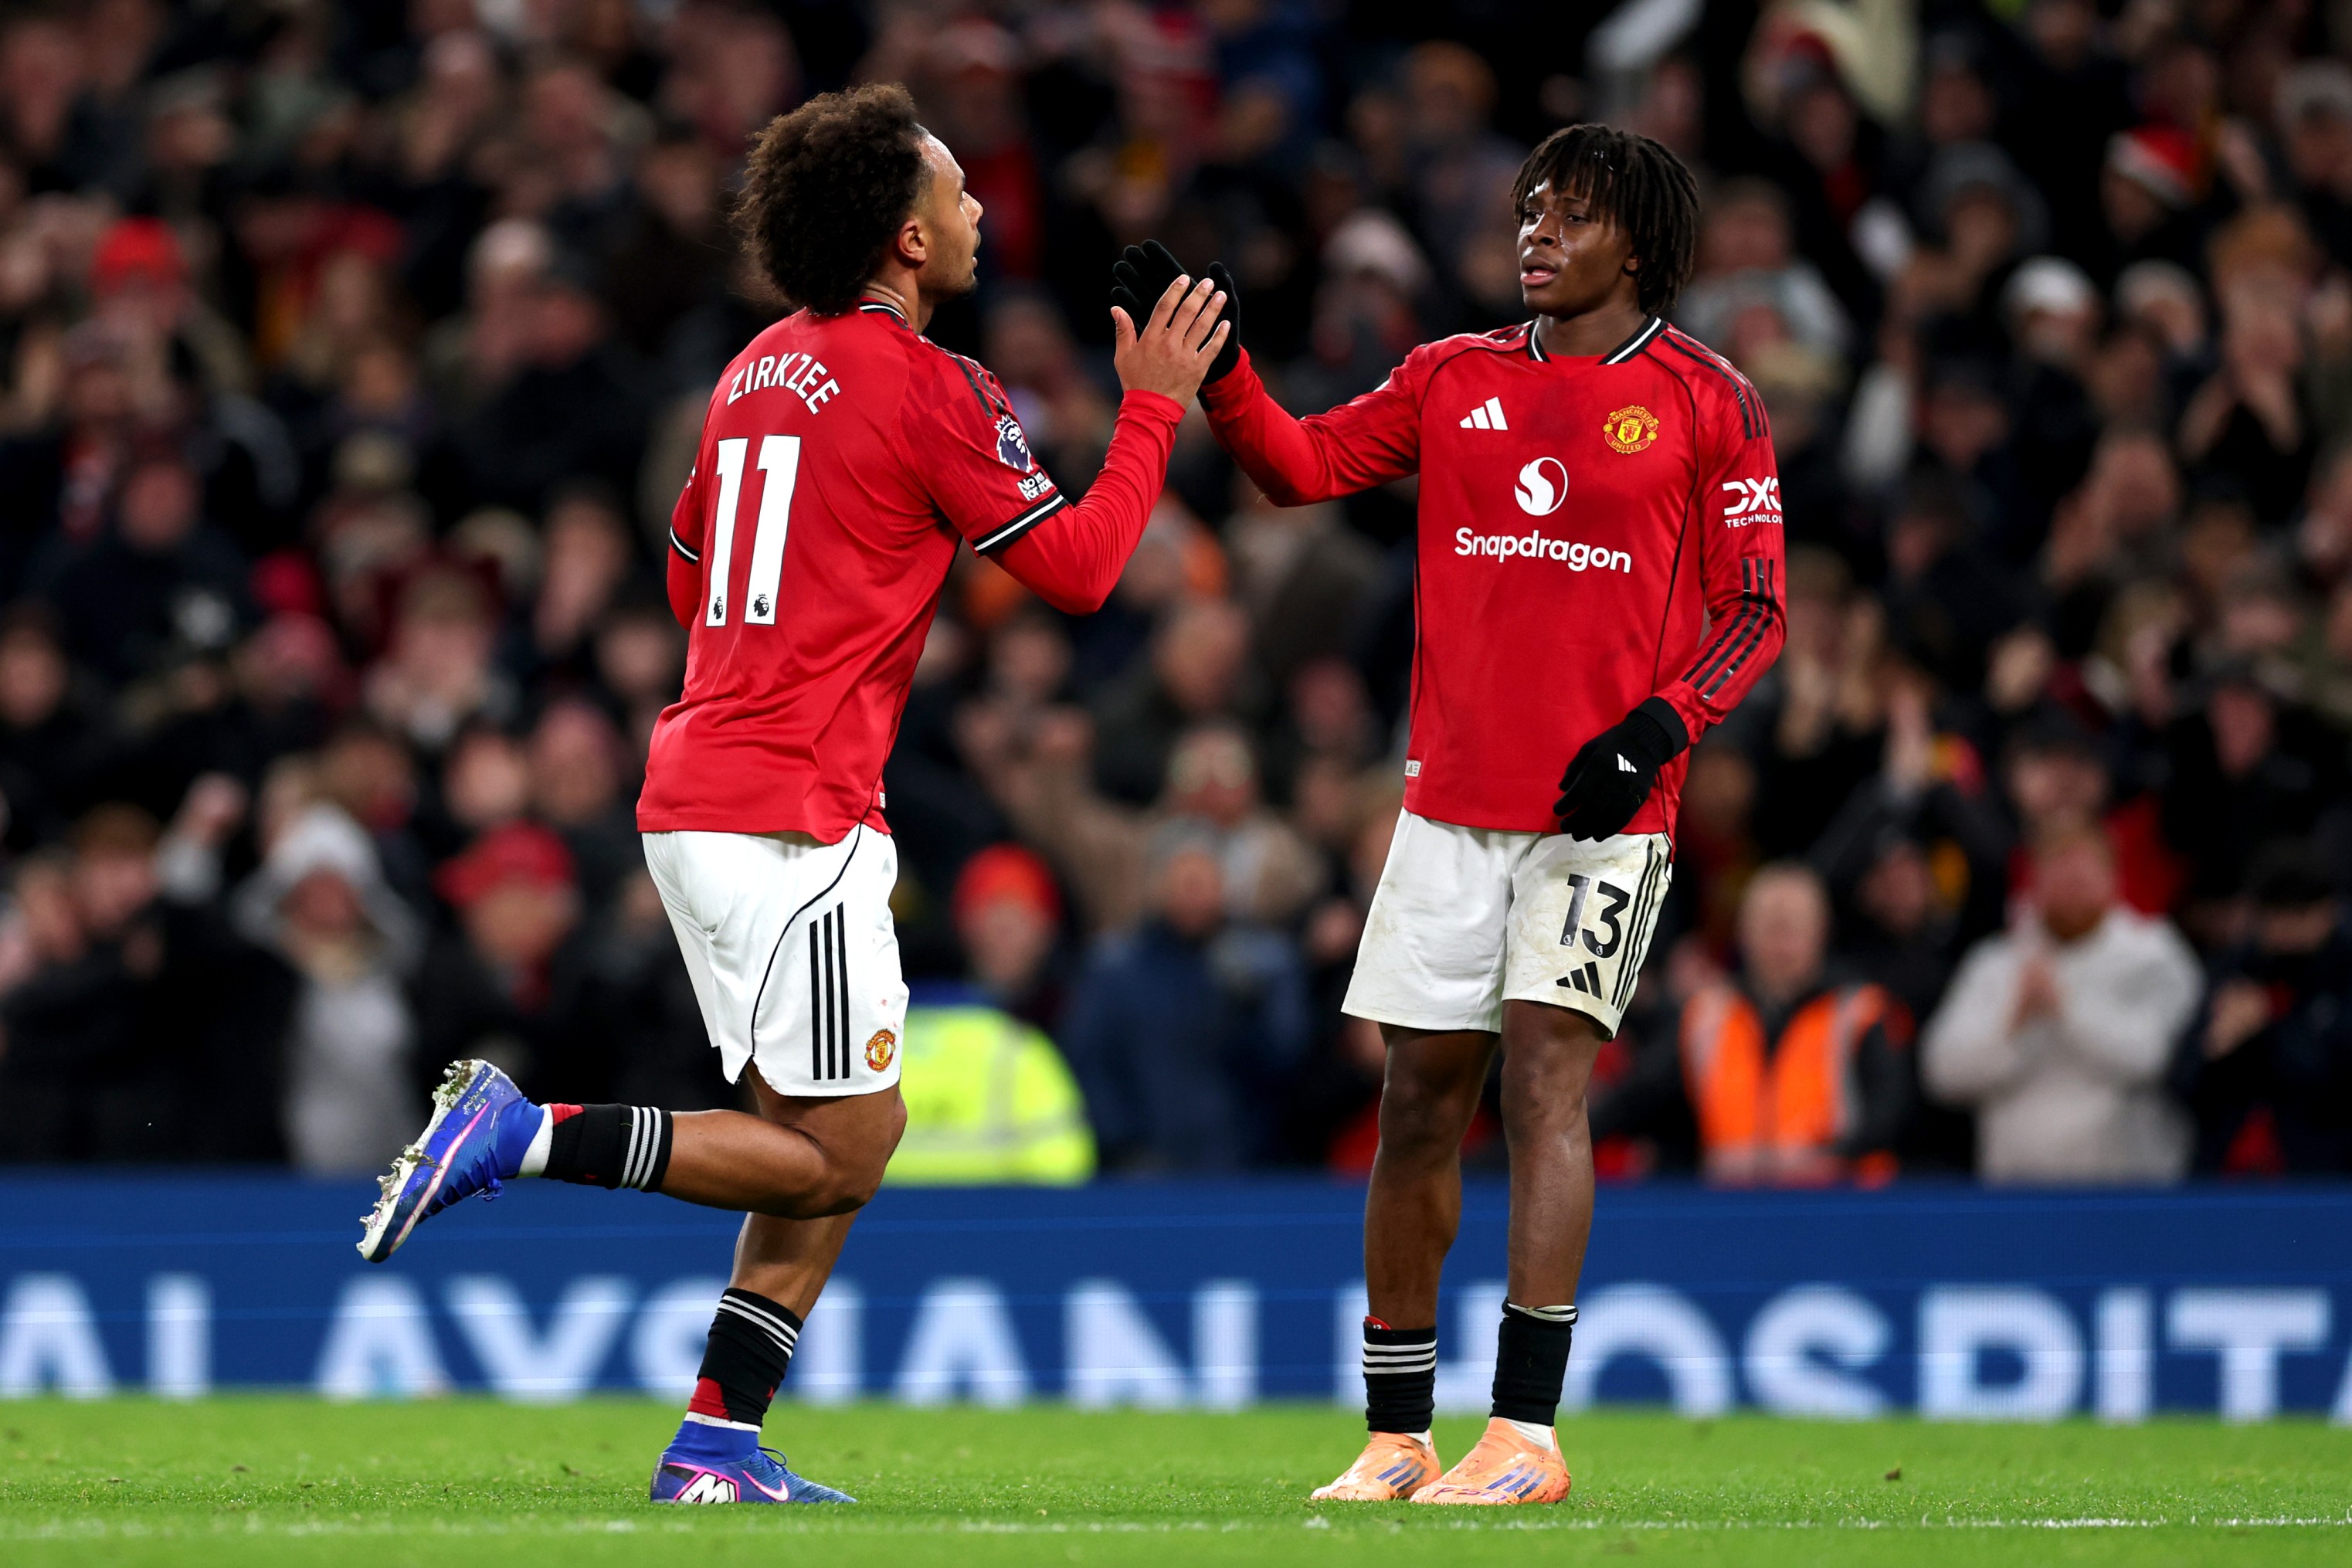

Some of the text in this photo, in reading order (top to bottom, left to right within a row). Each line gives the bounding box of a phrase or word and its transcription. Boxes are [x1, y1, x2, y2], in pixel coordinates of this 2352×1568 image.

[727, 352, 840, 415] ZIRKZEE
[1610, 440, 1641, 450] UNITED
[1611, 409, 1655, 429] MANCHESTER
[706, 434, 802, 626] 11
[1454, 527, 1632, 574] Snapdragon
[1560, 873, 1631, 959] 13
[1332, 1281, 2352, 1427] HOSPIT
